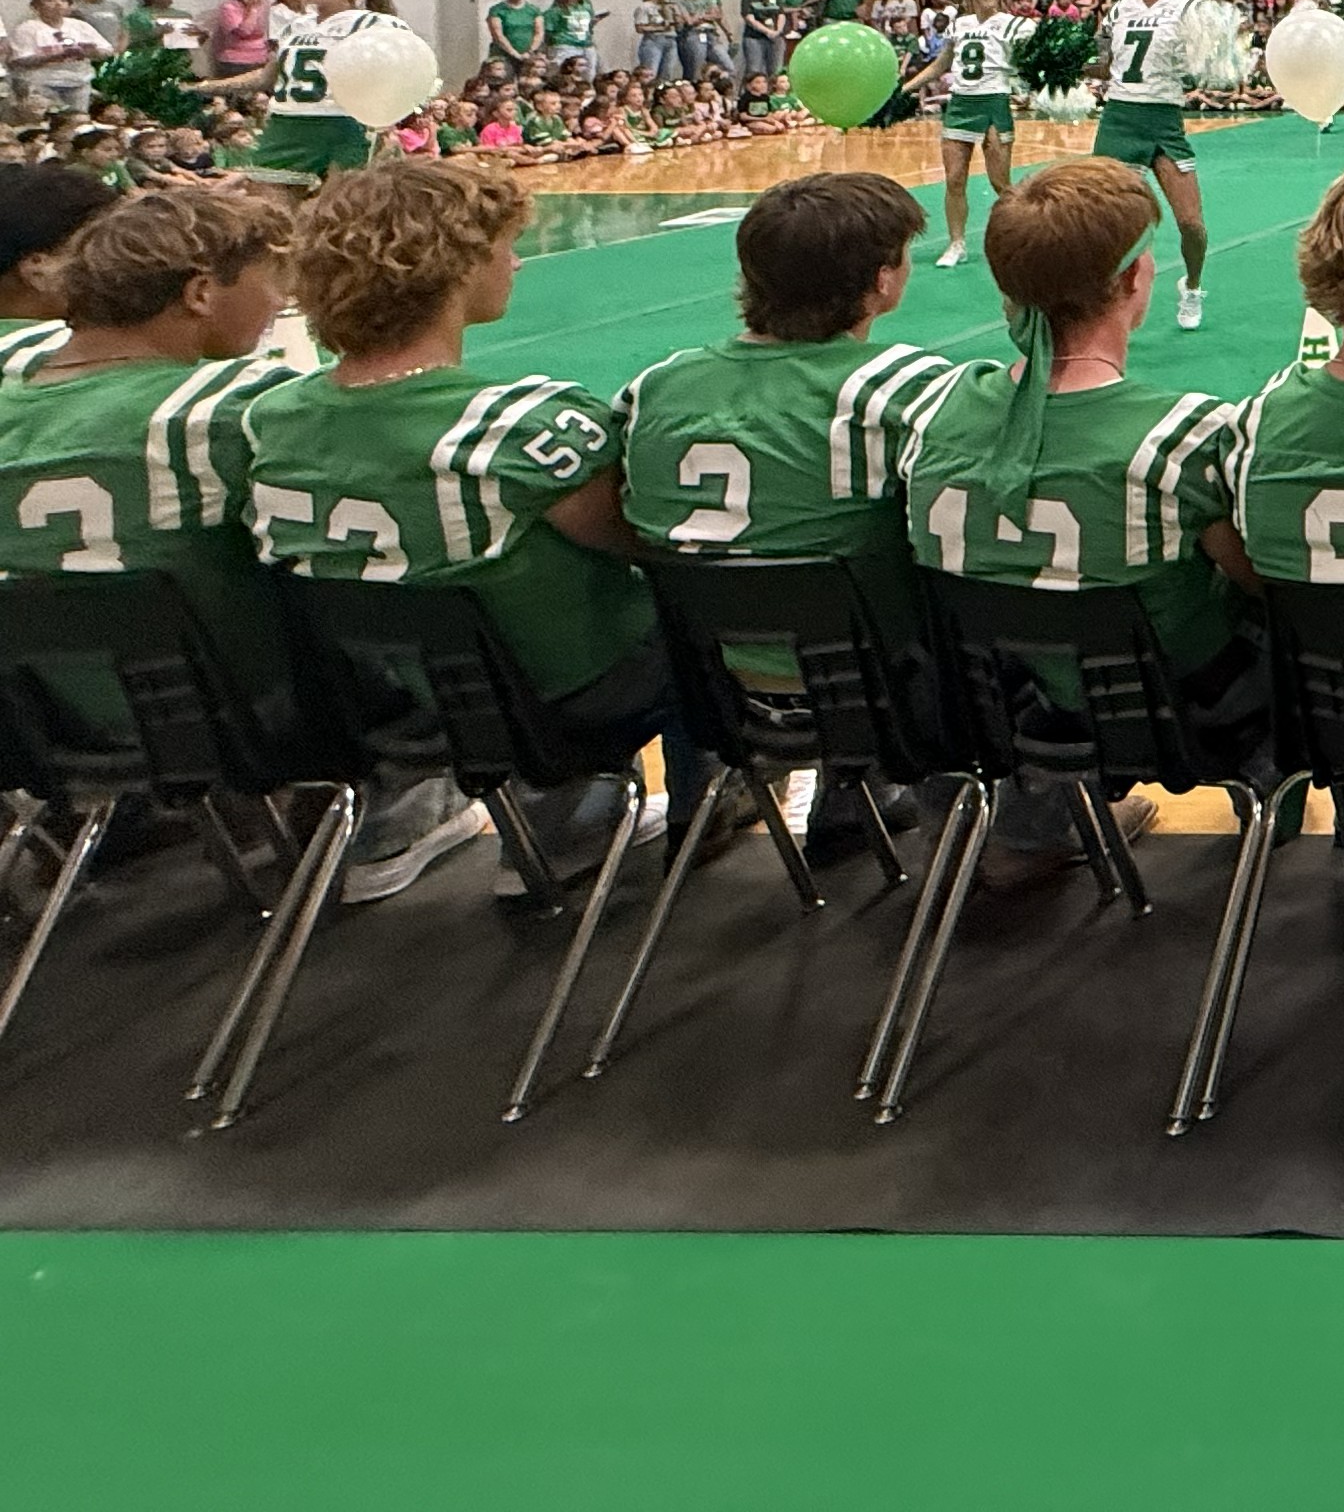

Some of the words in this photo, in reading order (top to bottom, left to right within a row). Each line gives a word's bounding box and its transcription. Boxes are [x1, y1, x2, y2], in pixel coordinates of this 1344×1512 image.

[961, 42, 985, 80] 9
[1122, 30, 1154, 83] 7
[523, 409, 608, 479] 53
